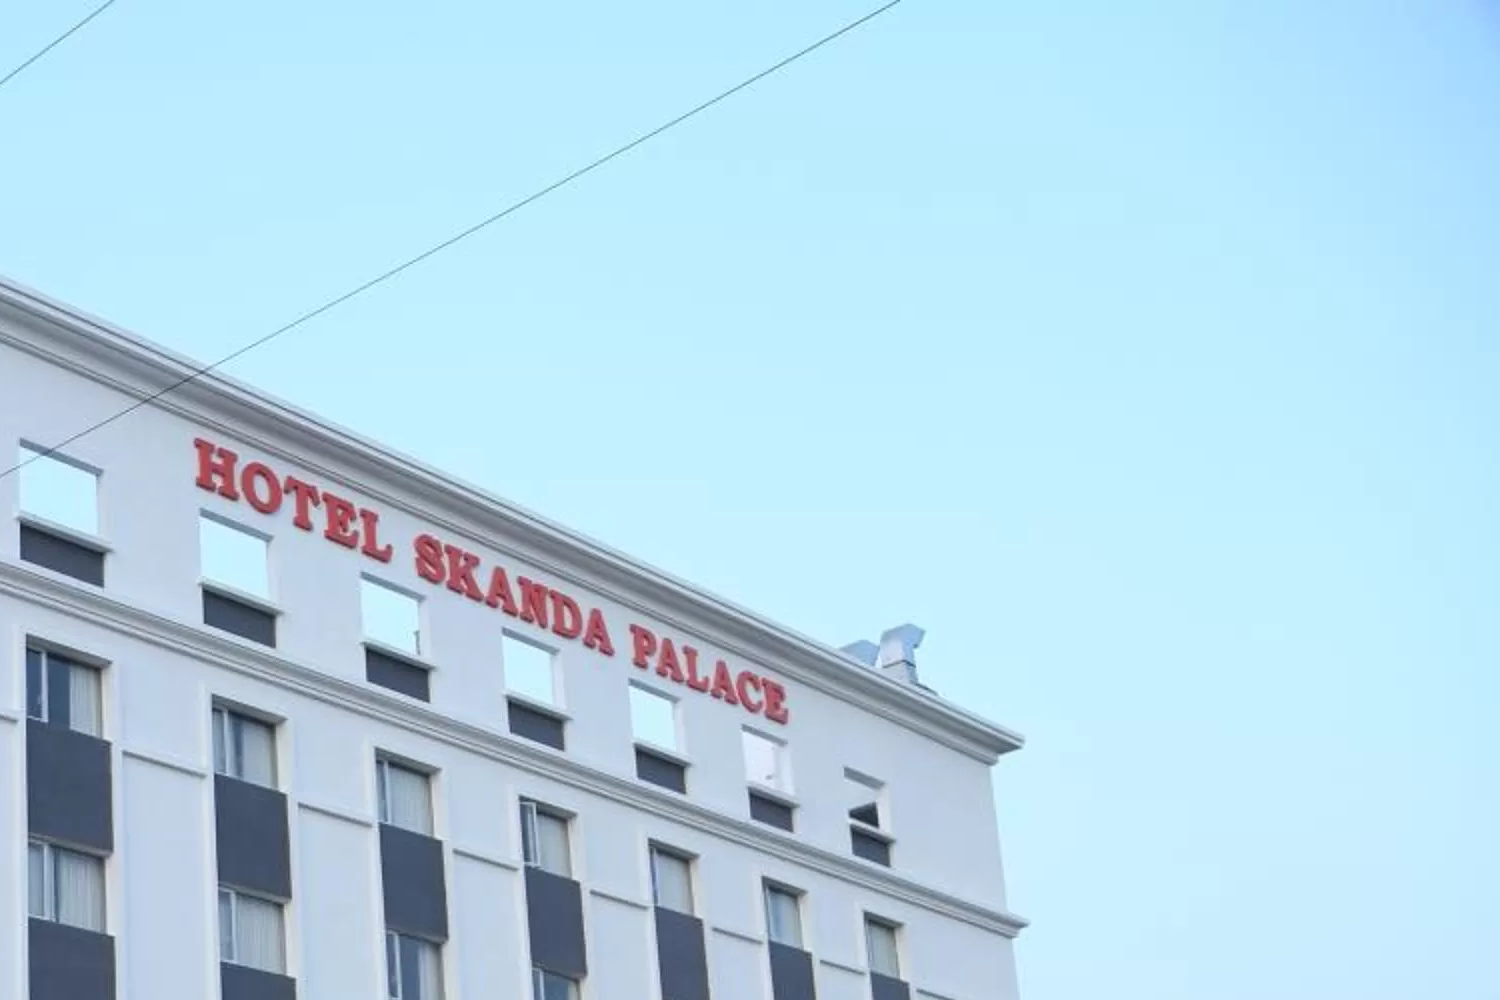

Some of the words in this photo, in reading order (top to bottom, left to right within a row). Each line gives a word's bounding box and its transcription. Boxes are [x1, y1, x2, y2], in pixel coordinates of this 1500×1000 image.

[194, 438, 392, 562] HOTEL
[413, 534, 614, 656] SKANDA
[630, 624, 788, 724] PALACE
